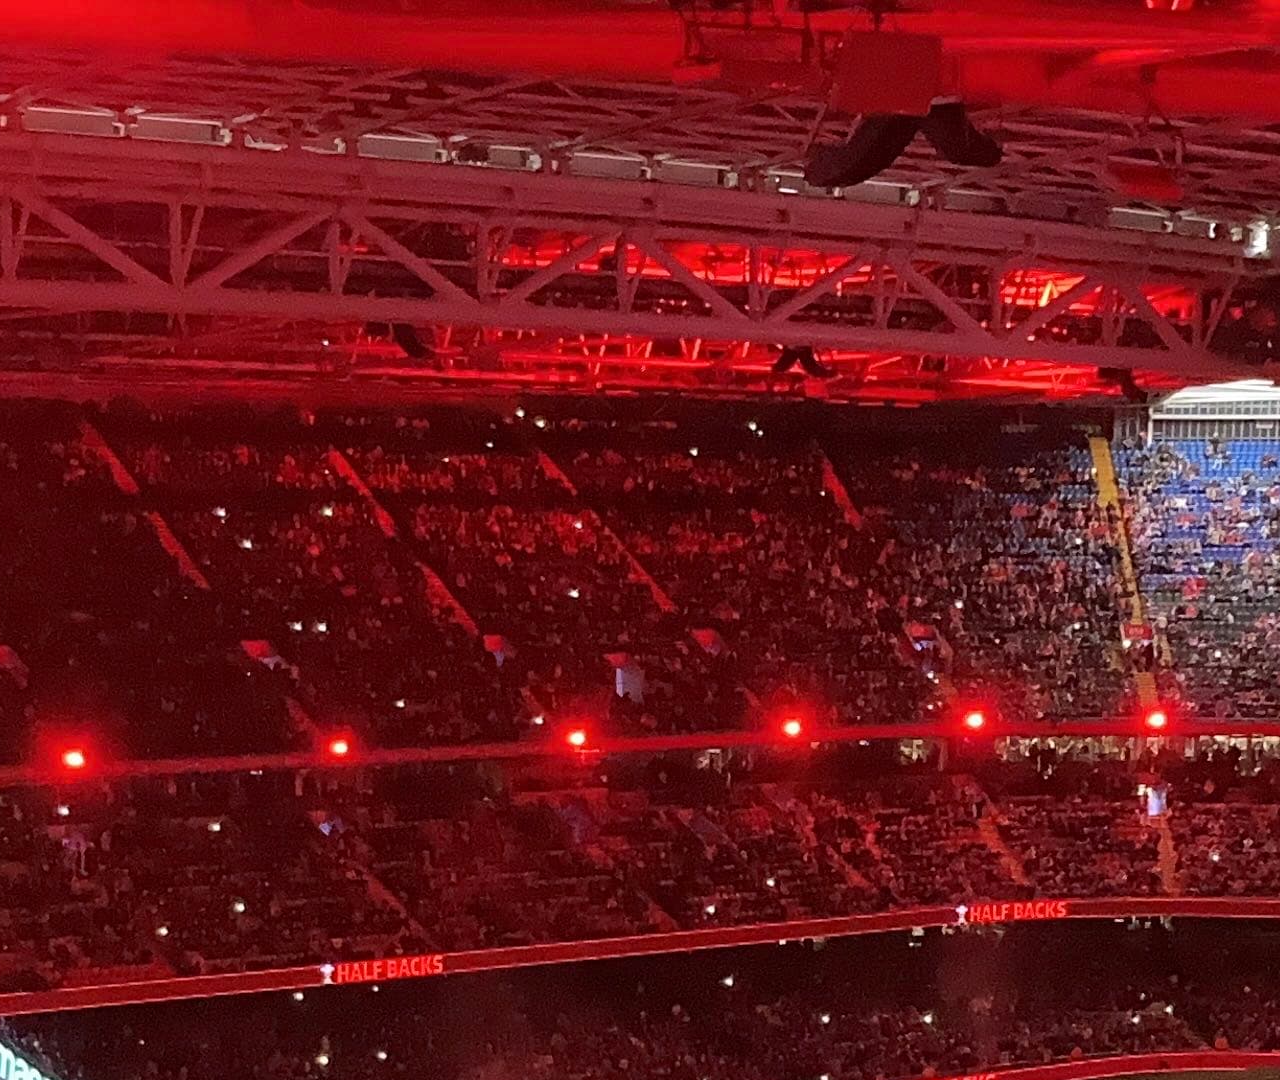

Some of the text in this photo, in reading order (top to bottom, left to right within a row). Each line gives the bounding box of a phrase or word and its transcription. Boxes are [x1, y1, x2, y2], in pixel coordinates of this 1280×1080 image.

[970, 901, 1067, 922] HALF BACKS
[336, 955, 443, 983] HALF BACKS
